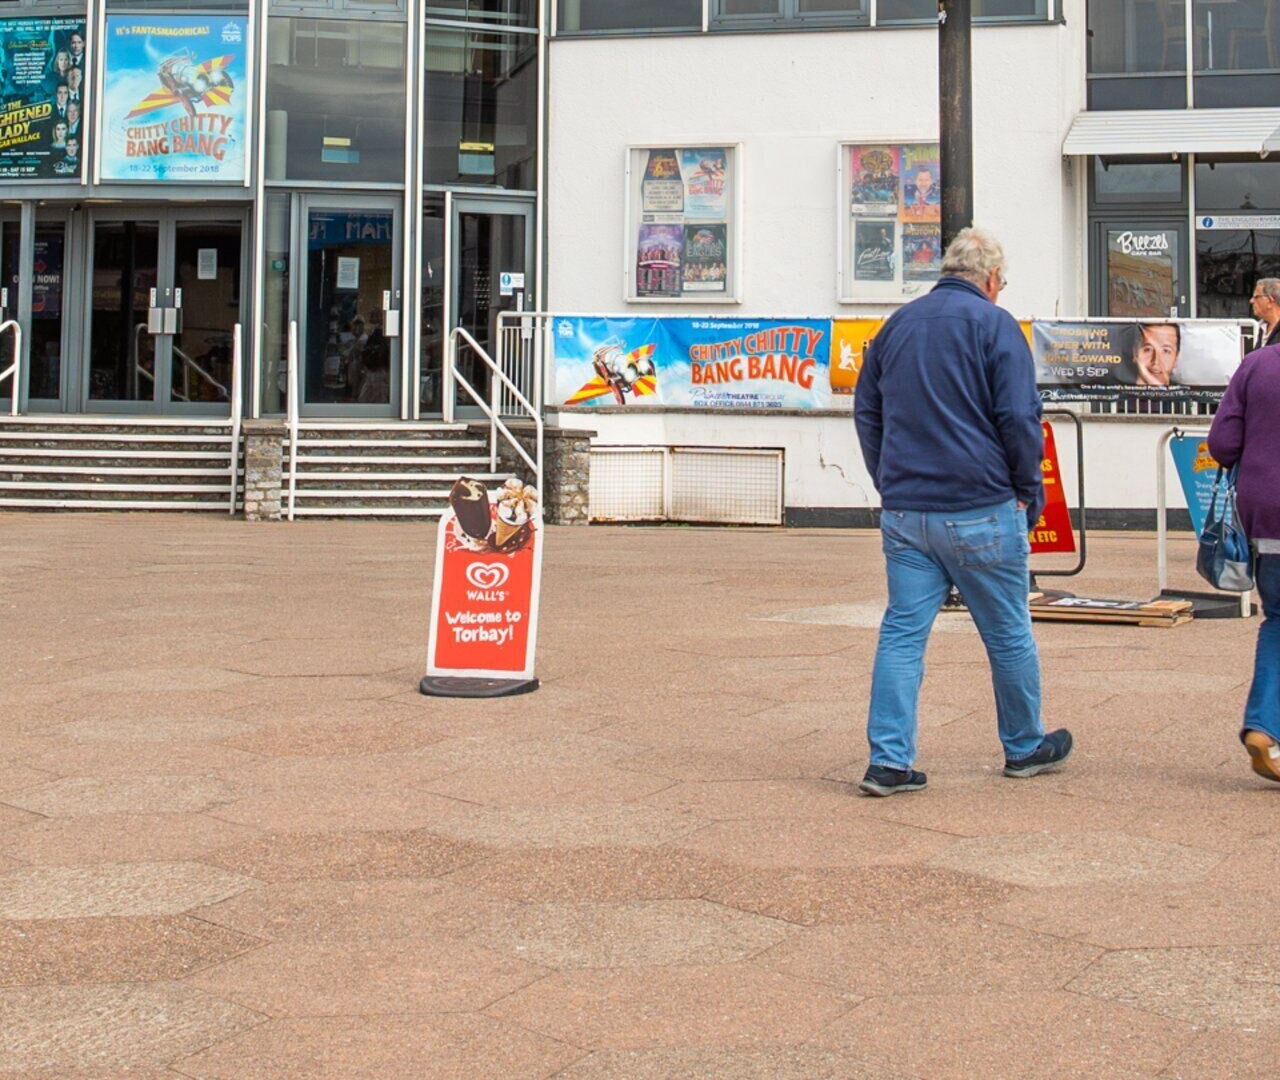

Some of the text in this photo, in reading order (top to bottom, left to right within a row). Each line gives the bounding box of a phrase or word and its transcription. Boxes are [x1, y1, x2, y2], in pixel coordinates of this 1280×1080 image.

[222, 34, 241, 42] TOPS
[8, 100, 21, 110] THE
[127, 113, 233, 139] CHITTY CHITTY
[11, 132, 41, 145] WALLACE
[126, 133, 228, 160] BANG BANG
[153, 164, 197, 174] September
[1117, 231, 1168, 254] Breezes
[38, 274, 60, 283] NOW!
[710, 322, 743, 330] September
[690, 326, 822, 360] CHITTY CHITTY
[1082, 342, 1110, 350] WITH
[1072, 354, 1121, 363] EDWARD
[691, 353, 816, 390] BANG BANG
[1051, 367, 1109, 377] WED 5 SEP
[1037, 531, 1058, 543] ETC
[466, 590, 505, 601] WALL'S
[445, 610, 521, 624] Welcome to
[452, 625, 514, 645] Torbay!
